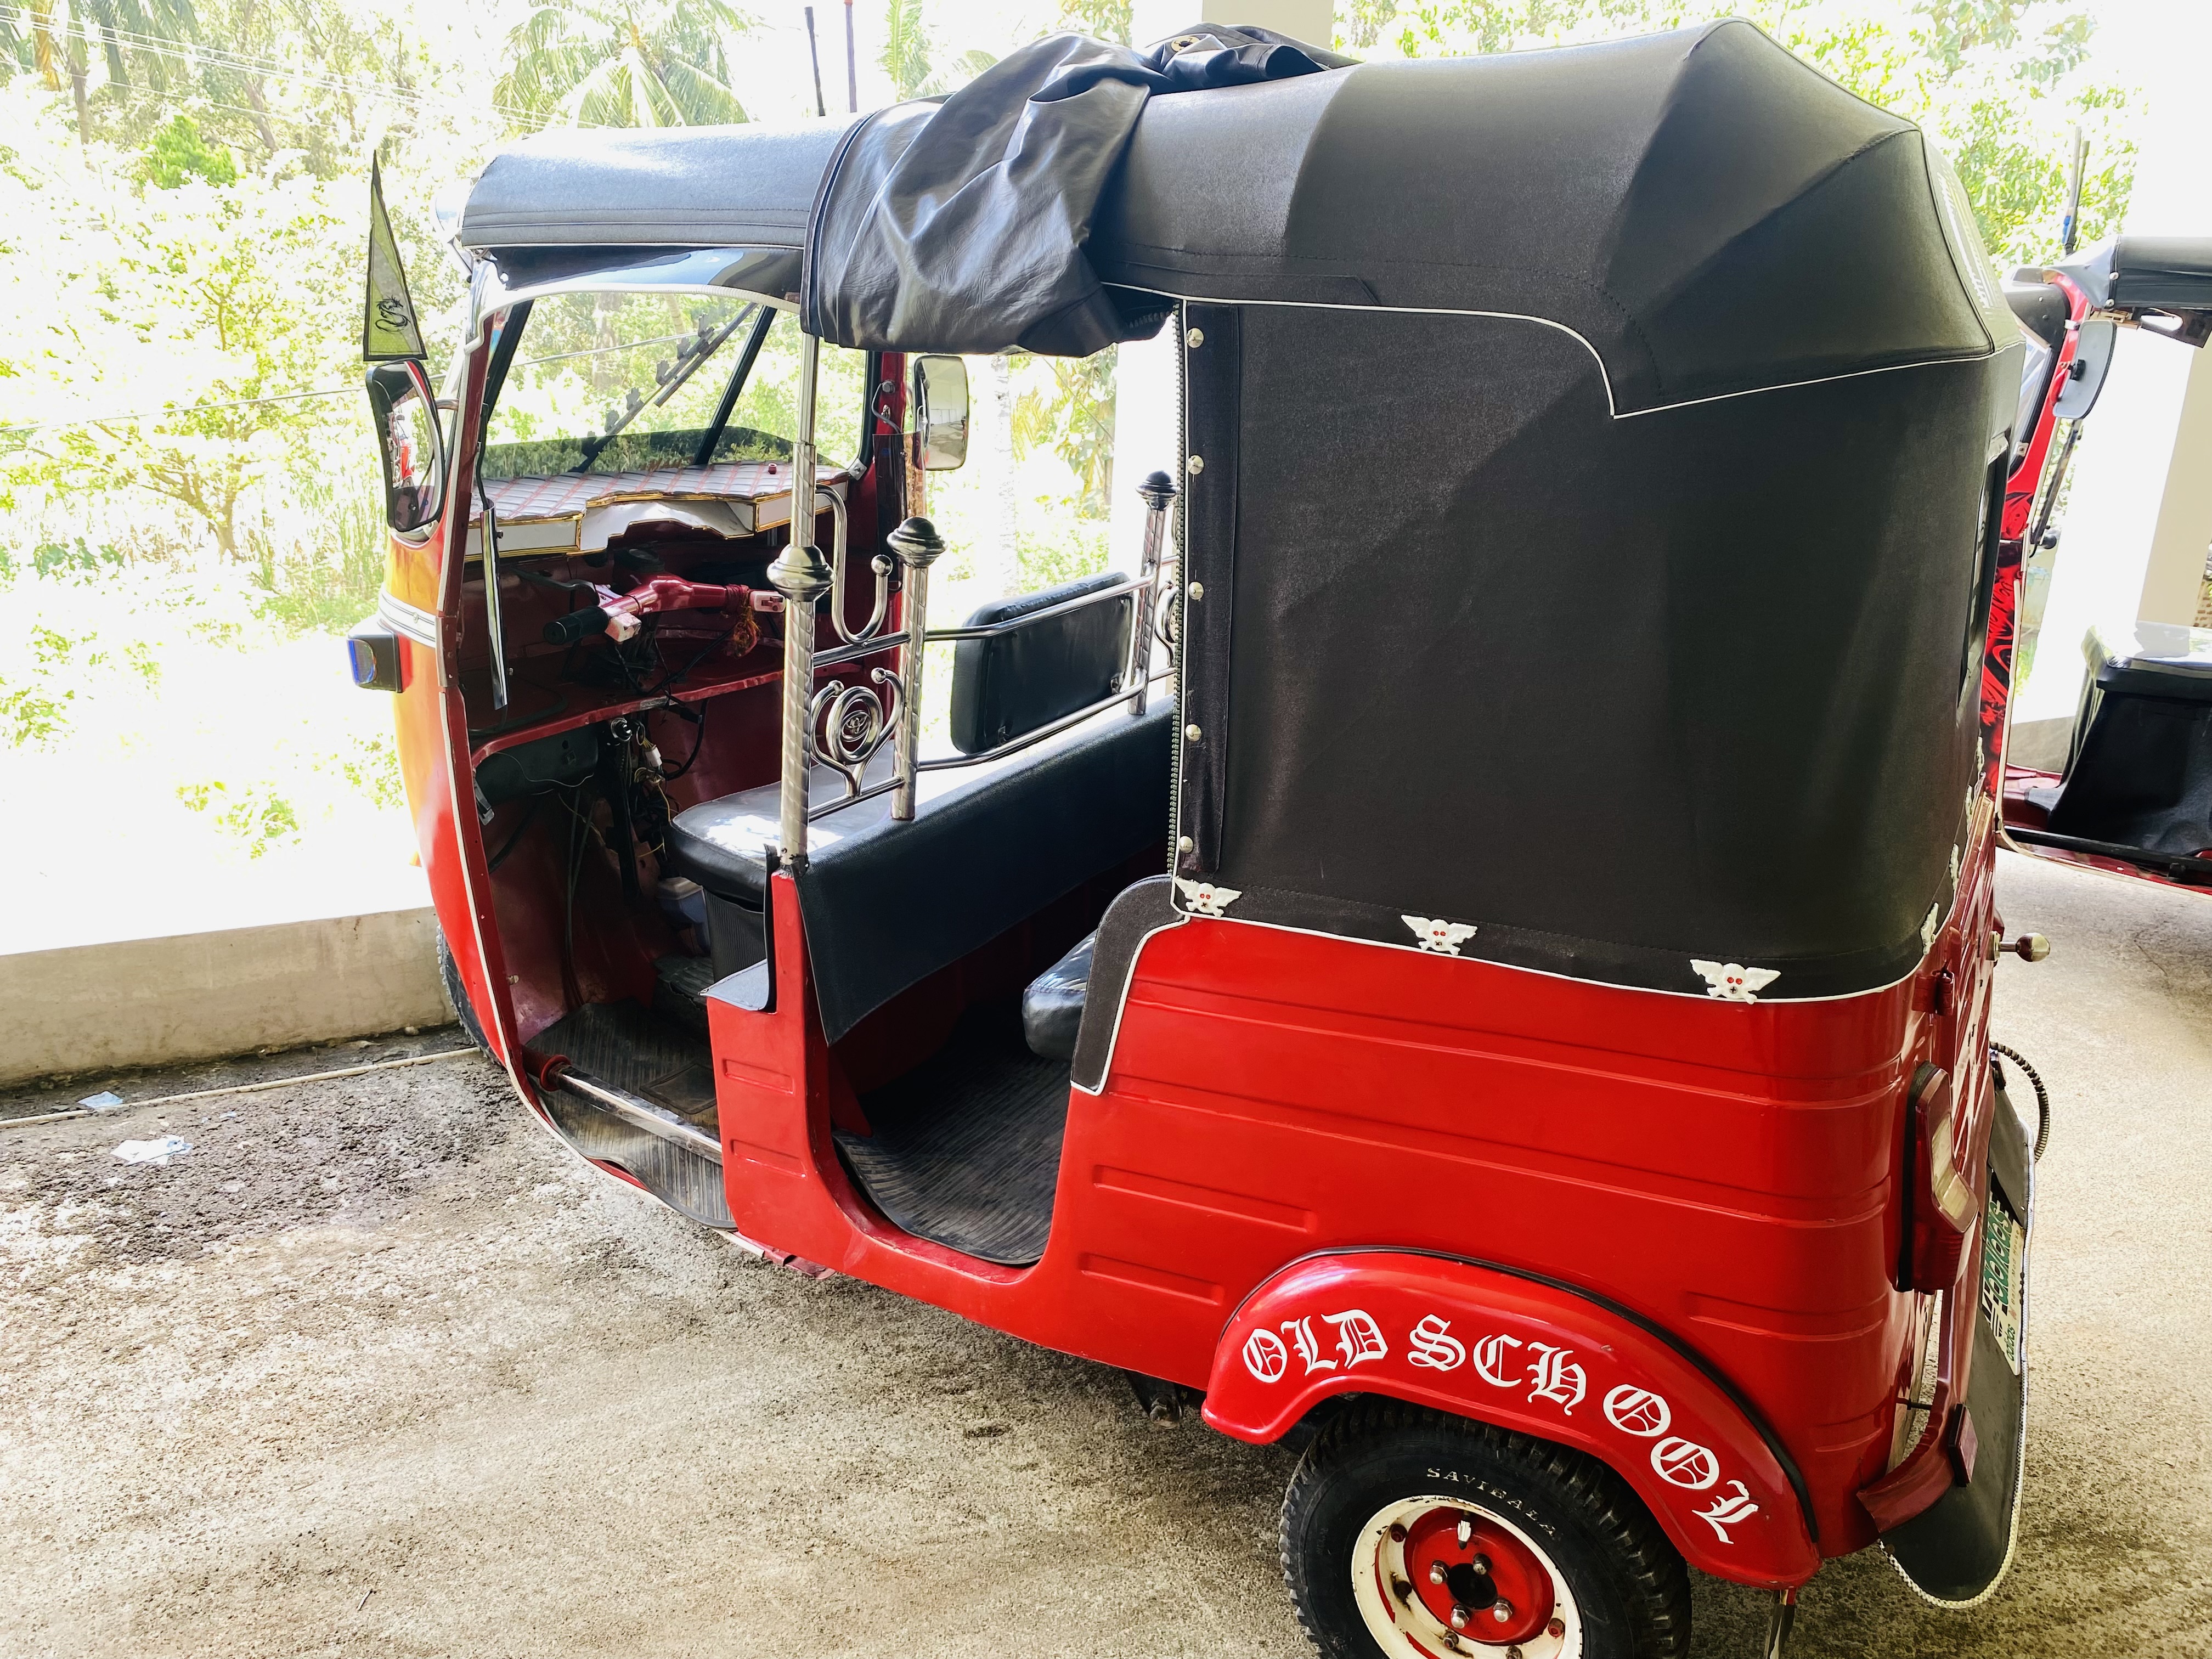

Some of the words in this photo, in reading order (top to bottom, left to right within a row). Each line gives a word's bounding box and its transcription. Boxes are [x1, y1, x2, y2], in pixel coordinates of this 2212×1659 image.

[1984, 1200, 2012, 1305] adidas
[1242, 1309, 1389, 1383] OLD
[2004, 1323, 2016, 1362] adidas
